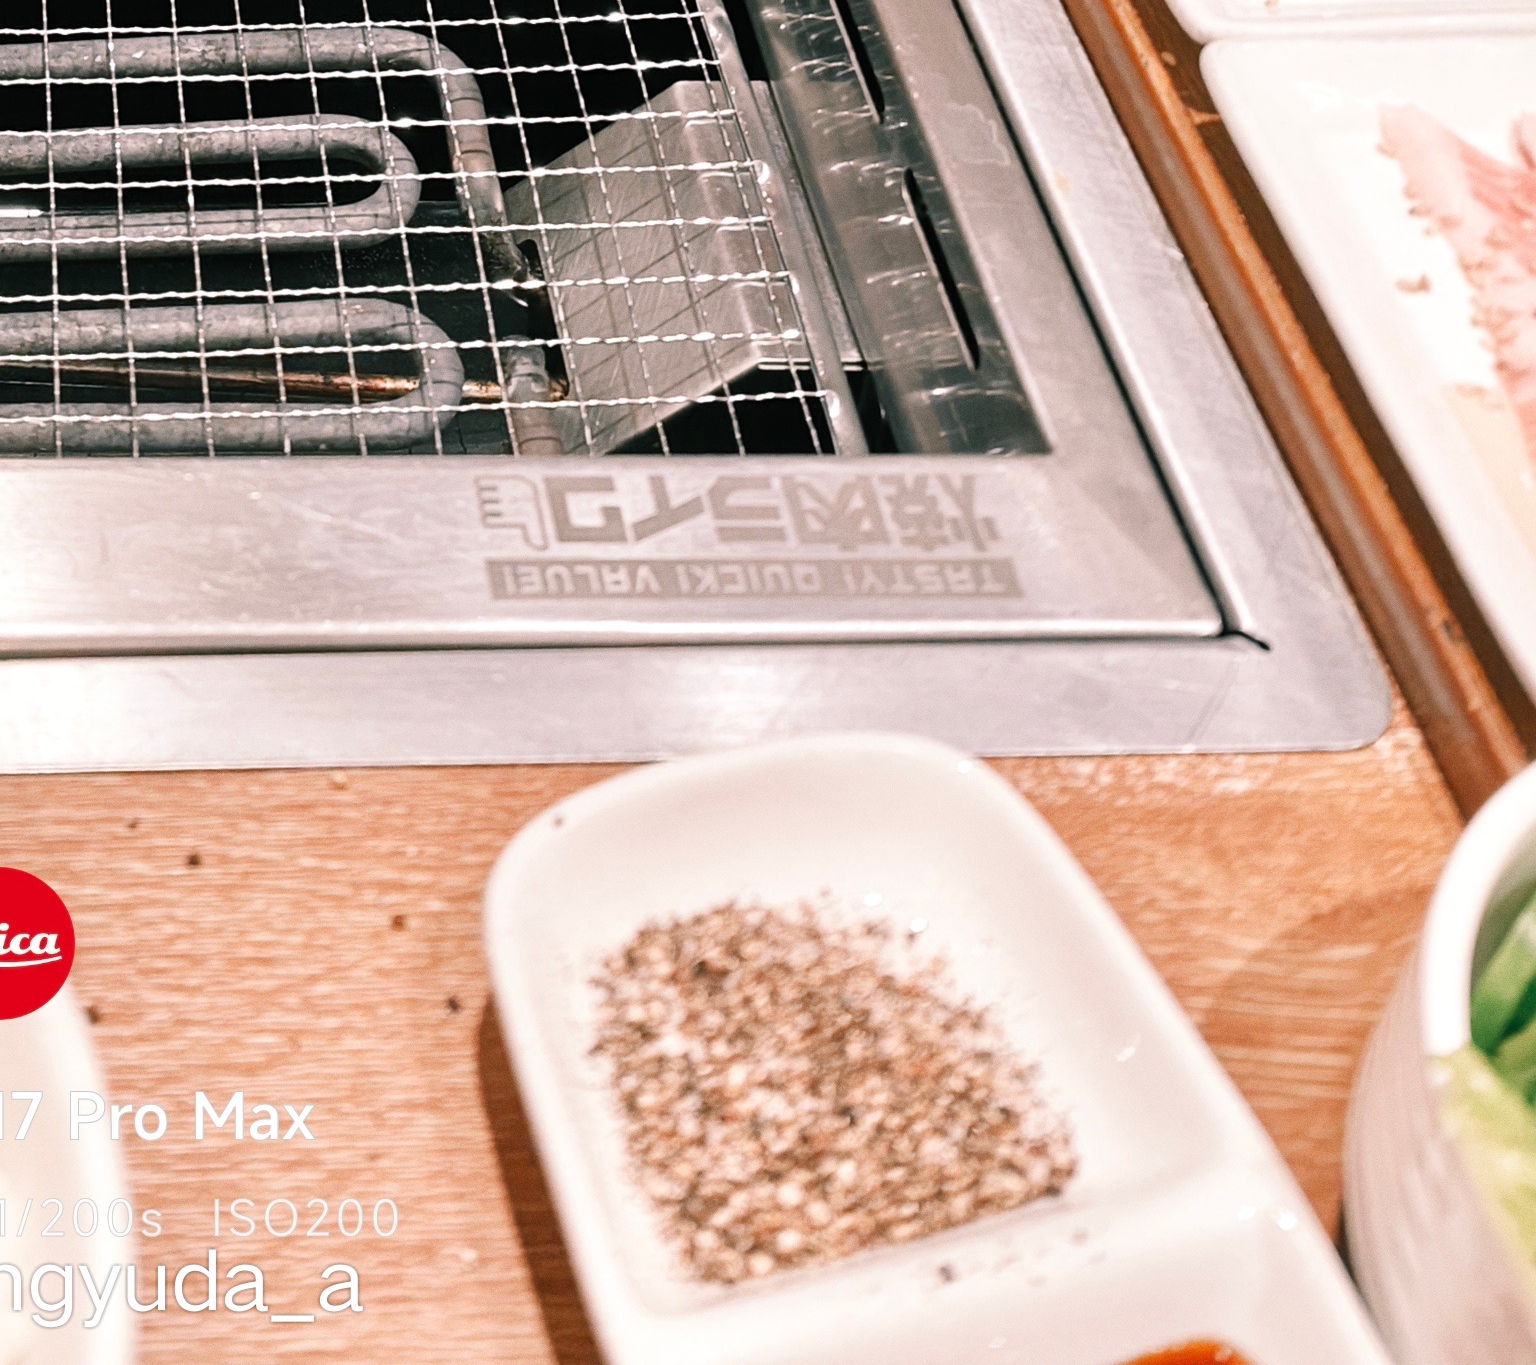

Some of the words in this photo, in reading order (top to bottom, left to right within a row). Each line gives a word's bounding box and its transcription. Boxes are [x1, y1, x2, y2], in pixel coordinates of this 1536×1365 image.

[541, 473, 1002, 554] 焼肉ライク
[501, 563, 662, 594] VALUE!
[674, 563, 822, 594] QUICK!
[840, 563, 1007, 594] TASTY!
